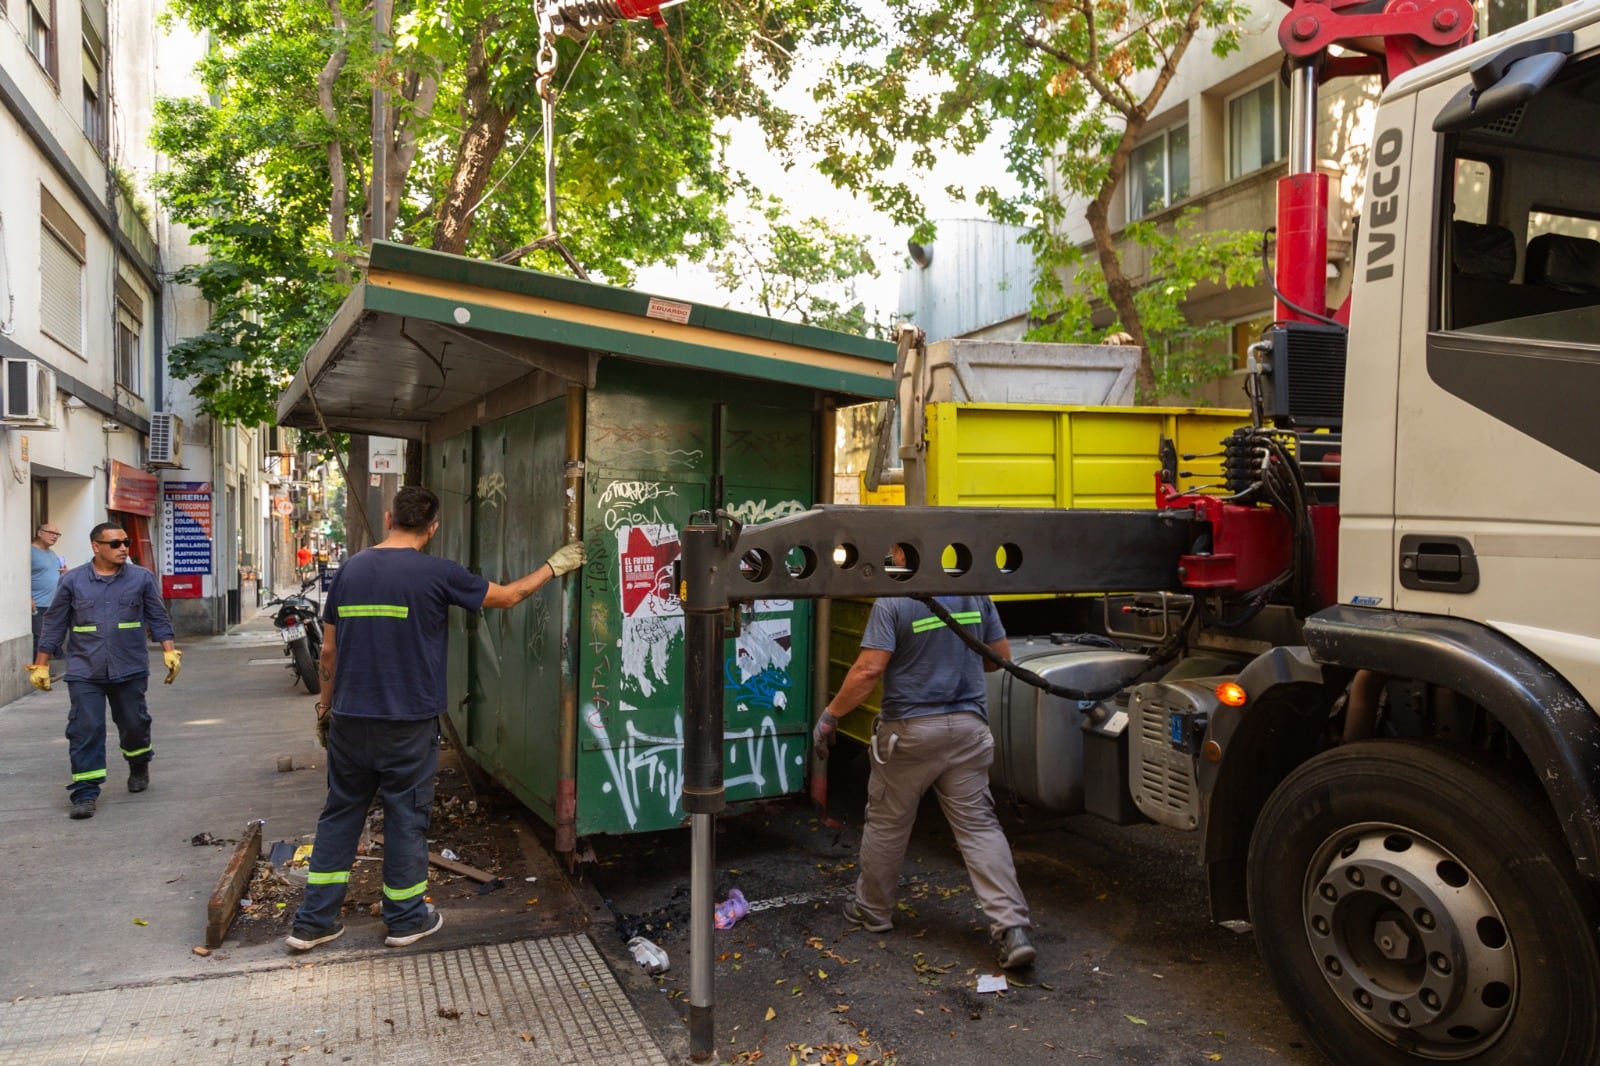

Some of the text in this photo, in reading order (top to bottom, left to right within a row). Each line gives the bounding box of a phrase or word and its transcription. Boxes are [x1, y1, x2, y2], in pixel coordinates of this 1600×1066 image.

[1366, 128, 1403, 283] IVECO
[651, 305, 688, 316] EDUARDO
[165, 502, 173, 574] FOTOCOPIAS
[625, 556, 654, 565] EL FUTURO
[625, 565, 633, 573] ES
[634, 565, 642, 573] DE
